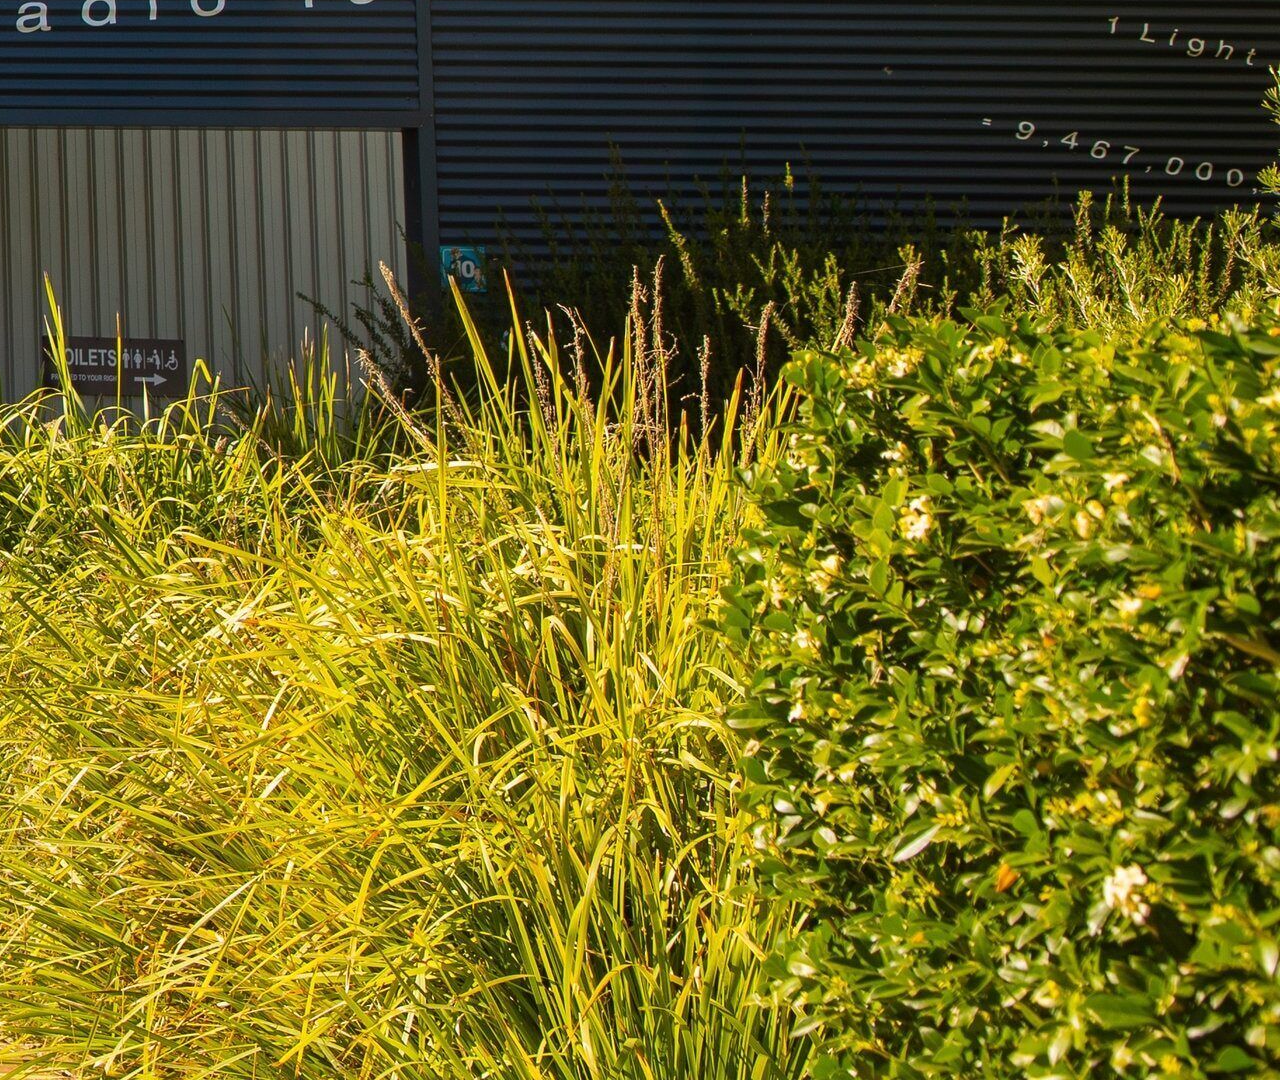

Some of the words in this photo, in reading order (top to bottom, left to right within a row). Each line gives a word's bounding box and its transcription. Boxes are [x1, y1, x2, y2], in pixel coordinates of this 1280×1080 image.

[1107, 15, 1120, 35] 1
[1139, 22, 1258, 66] Light
[1014, 120, 1259, 195] 9,467,000,
[451, 260, 476, 279] 10
[63, 347, 118, 367] OILETS
[103, 374, 118, 382] RIGH
